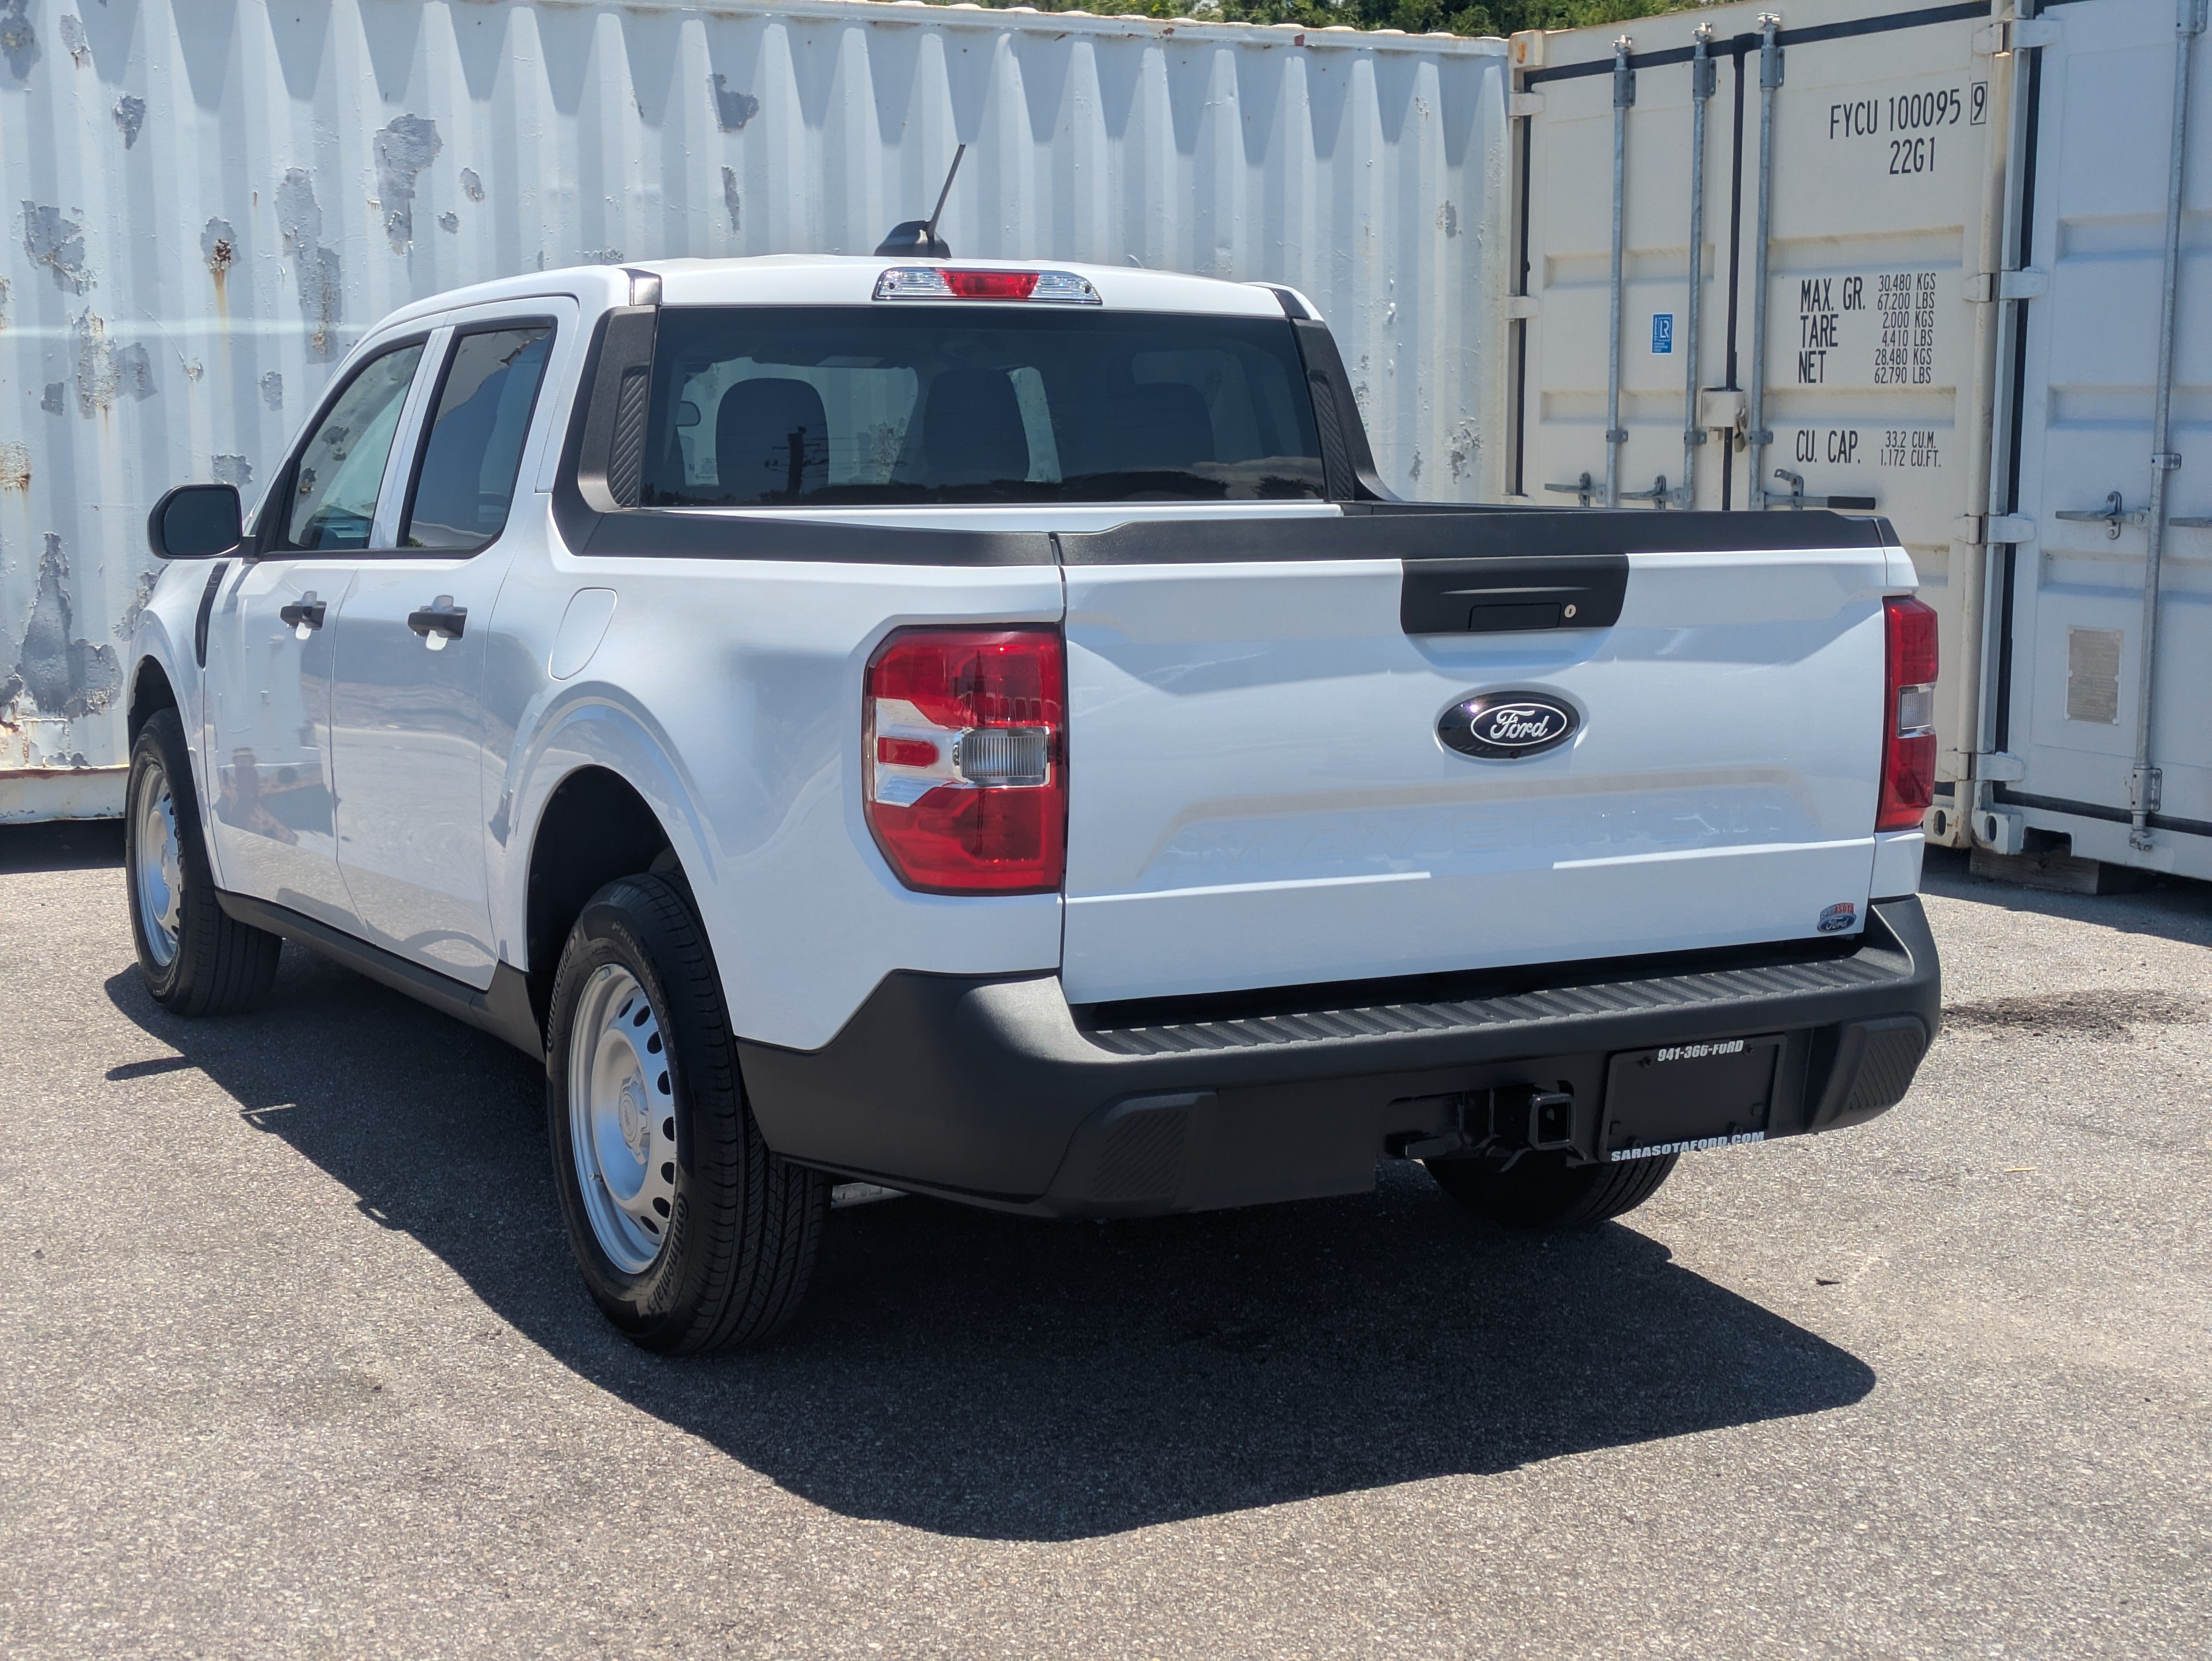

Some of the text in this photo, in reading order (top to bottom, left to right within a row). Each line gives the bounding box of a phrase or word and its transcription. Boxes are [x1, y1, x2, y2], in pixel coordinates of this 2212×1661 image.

[1830, 85, 1985, 139] FYCU 100095 9
[1889, 136, 1935, 175] 22G1
[1878, 272, 1936, 292] 30.480 KGS
[1800, 276, 1866, 312] MAX. GR.
[1877, 291, 1935, 310] 67.200 LBS
[1659, 320, 1670, 338] LR
[1914, 310, 1934, 328] KGS
[1800, 313, 1839, 348] TARE
[1914, 329, 1933, 347] LBS
[1875, 347, 1932, 365] 28.480 KGS
[1798, 350, 1827, 384] NET
[1913, 366, 1931, 384] LBS
[1796, 430, 1861, 464] CU. CAP.
[1885, 431, 1936, 449] 33.2 CU.M.
[1880, 449, 1942, 467] 1.172 CU.FT.
[1490, 709, 1550, 739] Ford
[1825, 916, 1849, 930] Ford
[1657, 1040, 1744, 1062] 941-366-FORD
[1611, 1131, 1765, 1162] SARASOTAFORD.COM
